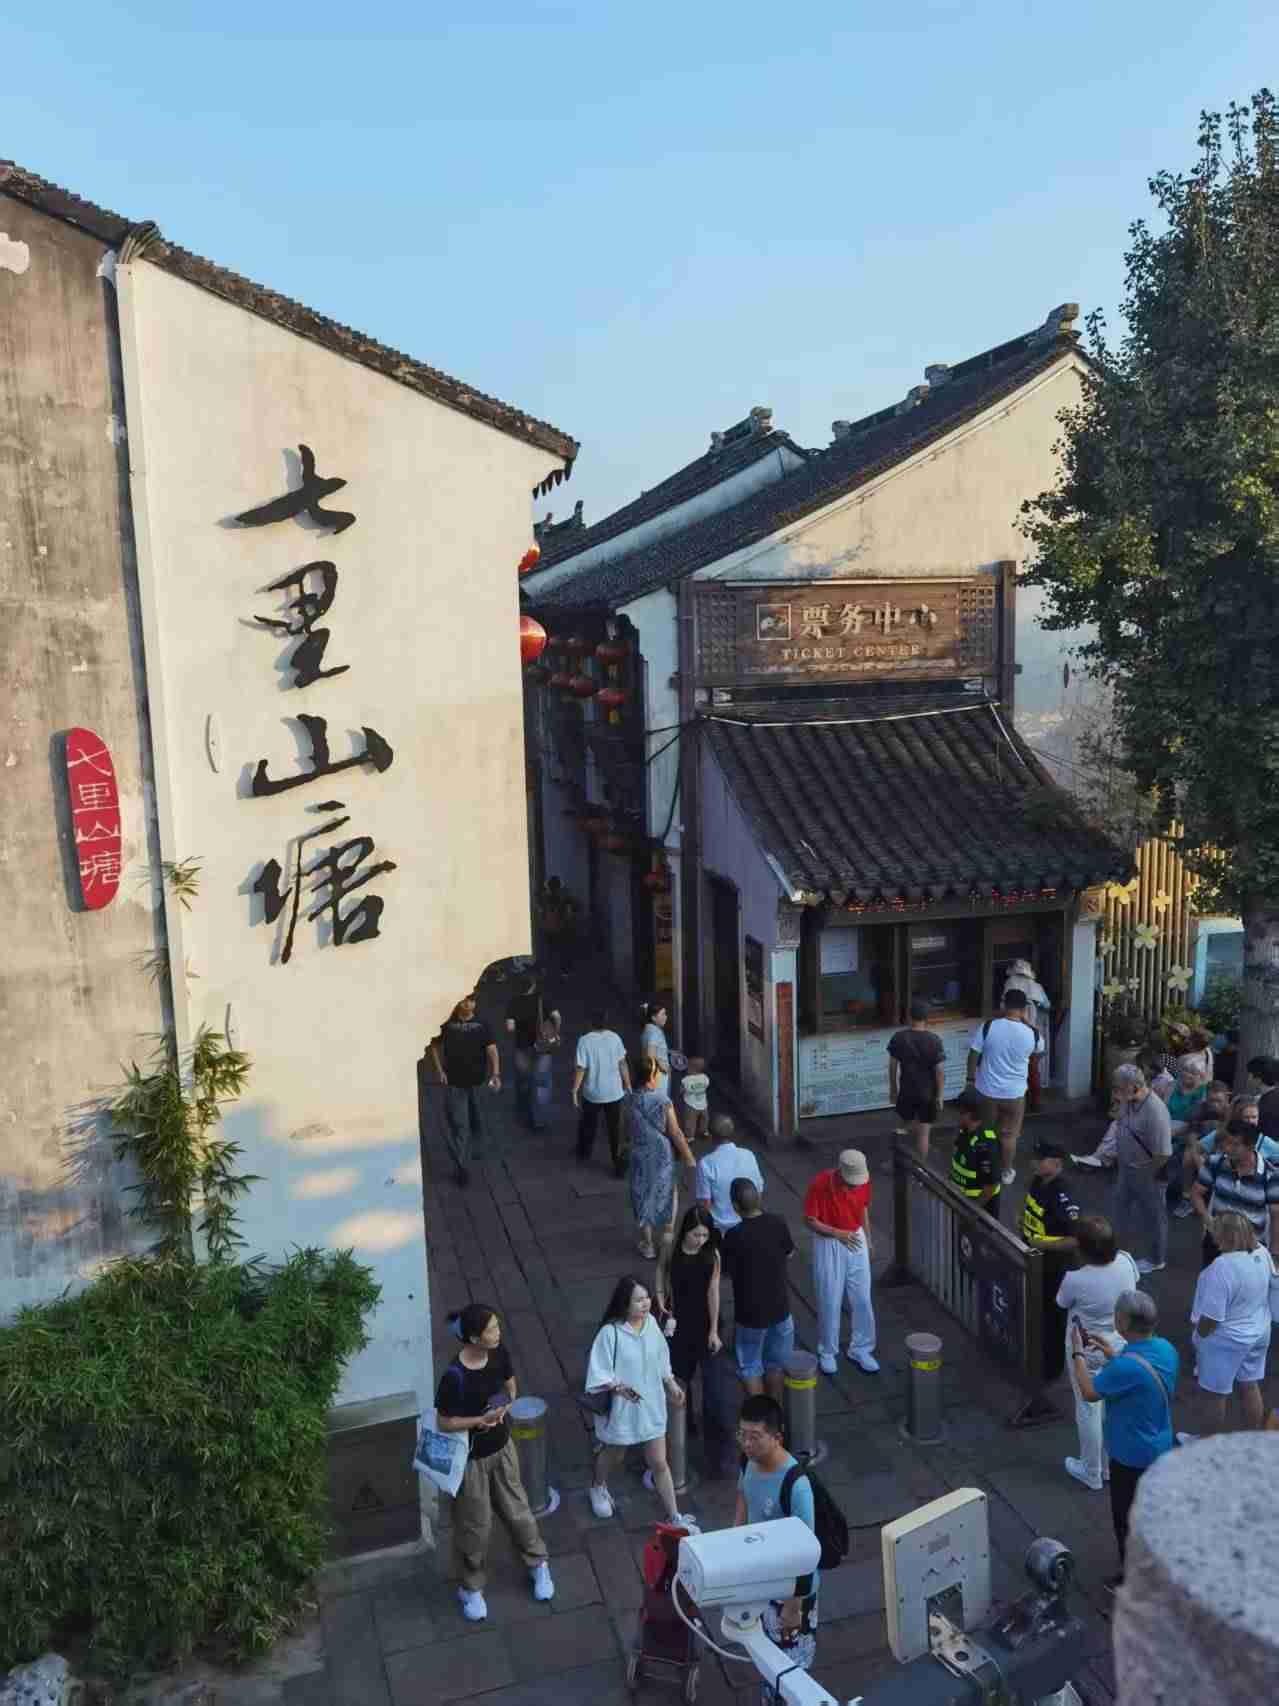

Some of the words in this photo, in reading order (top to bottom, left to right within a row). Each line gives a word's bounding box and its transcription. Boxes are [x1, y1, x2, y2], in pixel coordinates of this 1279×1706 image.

[800, 602, 938, 640] 票务中心
[782, 647, 847, 661] TICKET
[232, 444, 398, 964] 七里山塘
